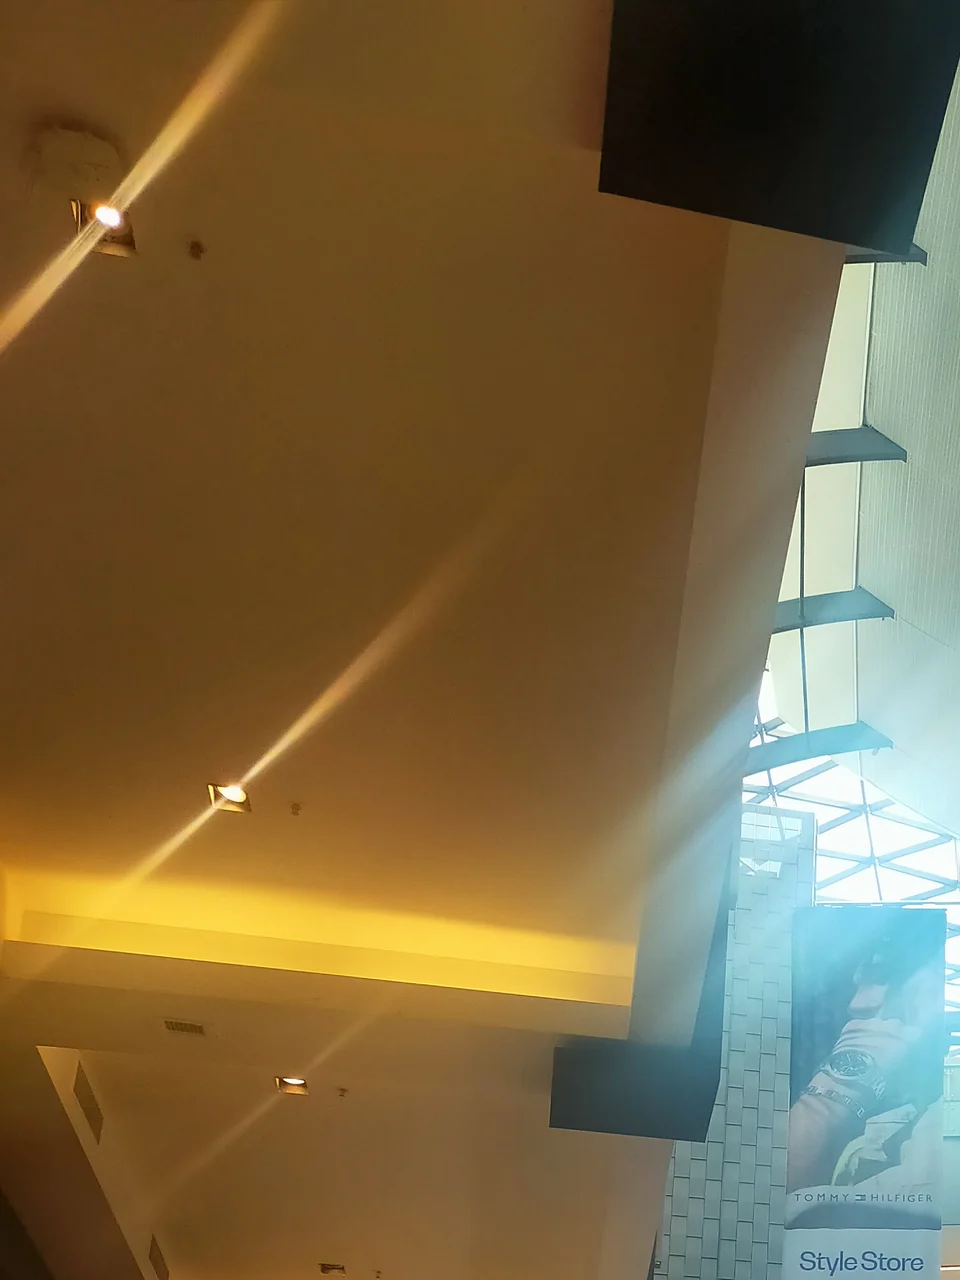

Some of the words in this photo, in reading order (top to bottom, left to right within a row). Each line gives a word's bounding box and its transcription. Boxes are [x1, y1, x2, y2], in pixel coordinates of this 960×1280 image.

[794, 1193, 850, 1202] TOMMY
[870, 1194, 933, 1203] HILFIGER
[799, 1250, 858, 1277] Style
[861, 1250, 924, 1272] Store
